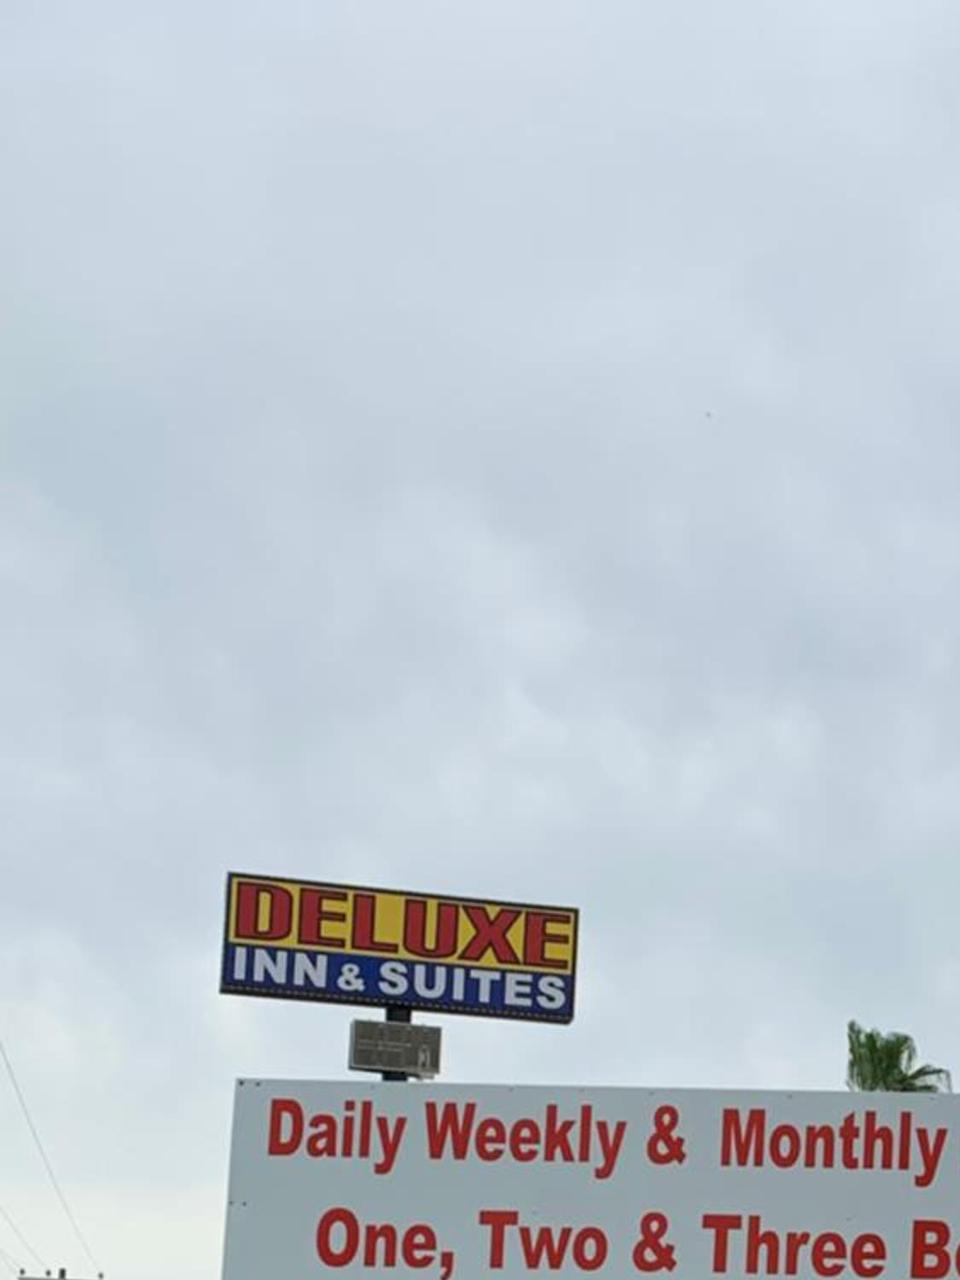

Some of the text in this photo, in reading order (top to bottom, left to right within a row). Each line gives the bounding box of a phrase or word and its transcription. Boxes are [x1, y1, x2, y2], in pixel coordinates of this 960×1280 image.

[234, 881, 572, 969] DELUXE
[232, 946, 567, 1010] INN & SUITES
[267, 1097, 407, 1173] Daily
[425, 1100, 626, 1178] Weekly
[647, 1104, 685, 1165] &
[719, 1108, 947, 1187] Monthly
[315, 1207, 454, 1275] One,
[480, 1209, 609, 1270] Two
[632, 1212, 677, 1271] &
[701, 1213, 888, 1277] Three
